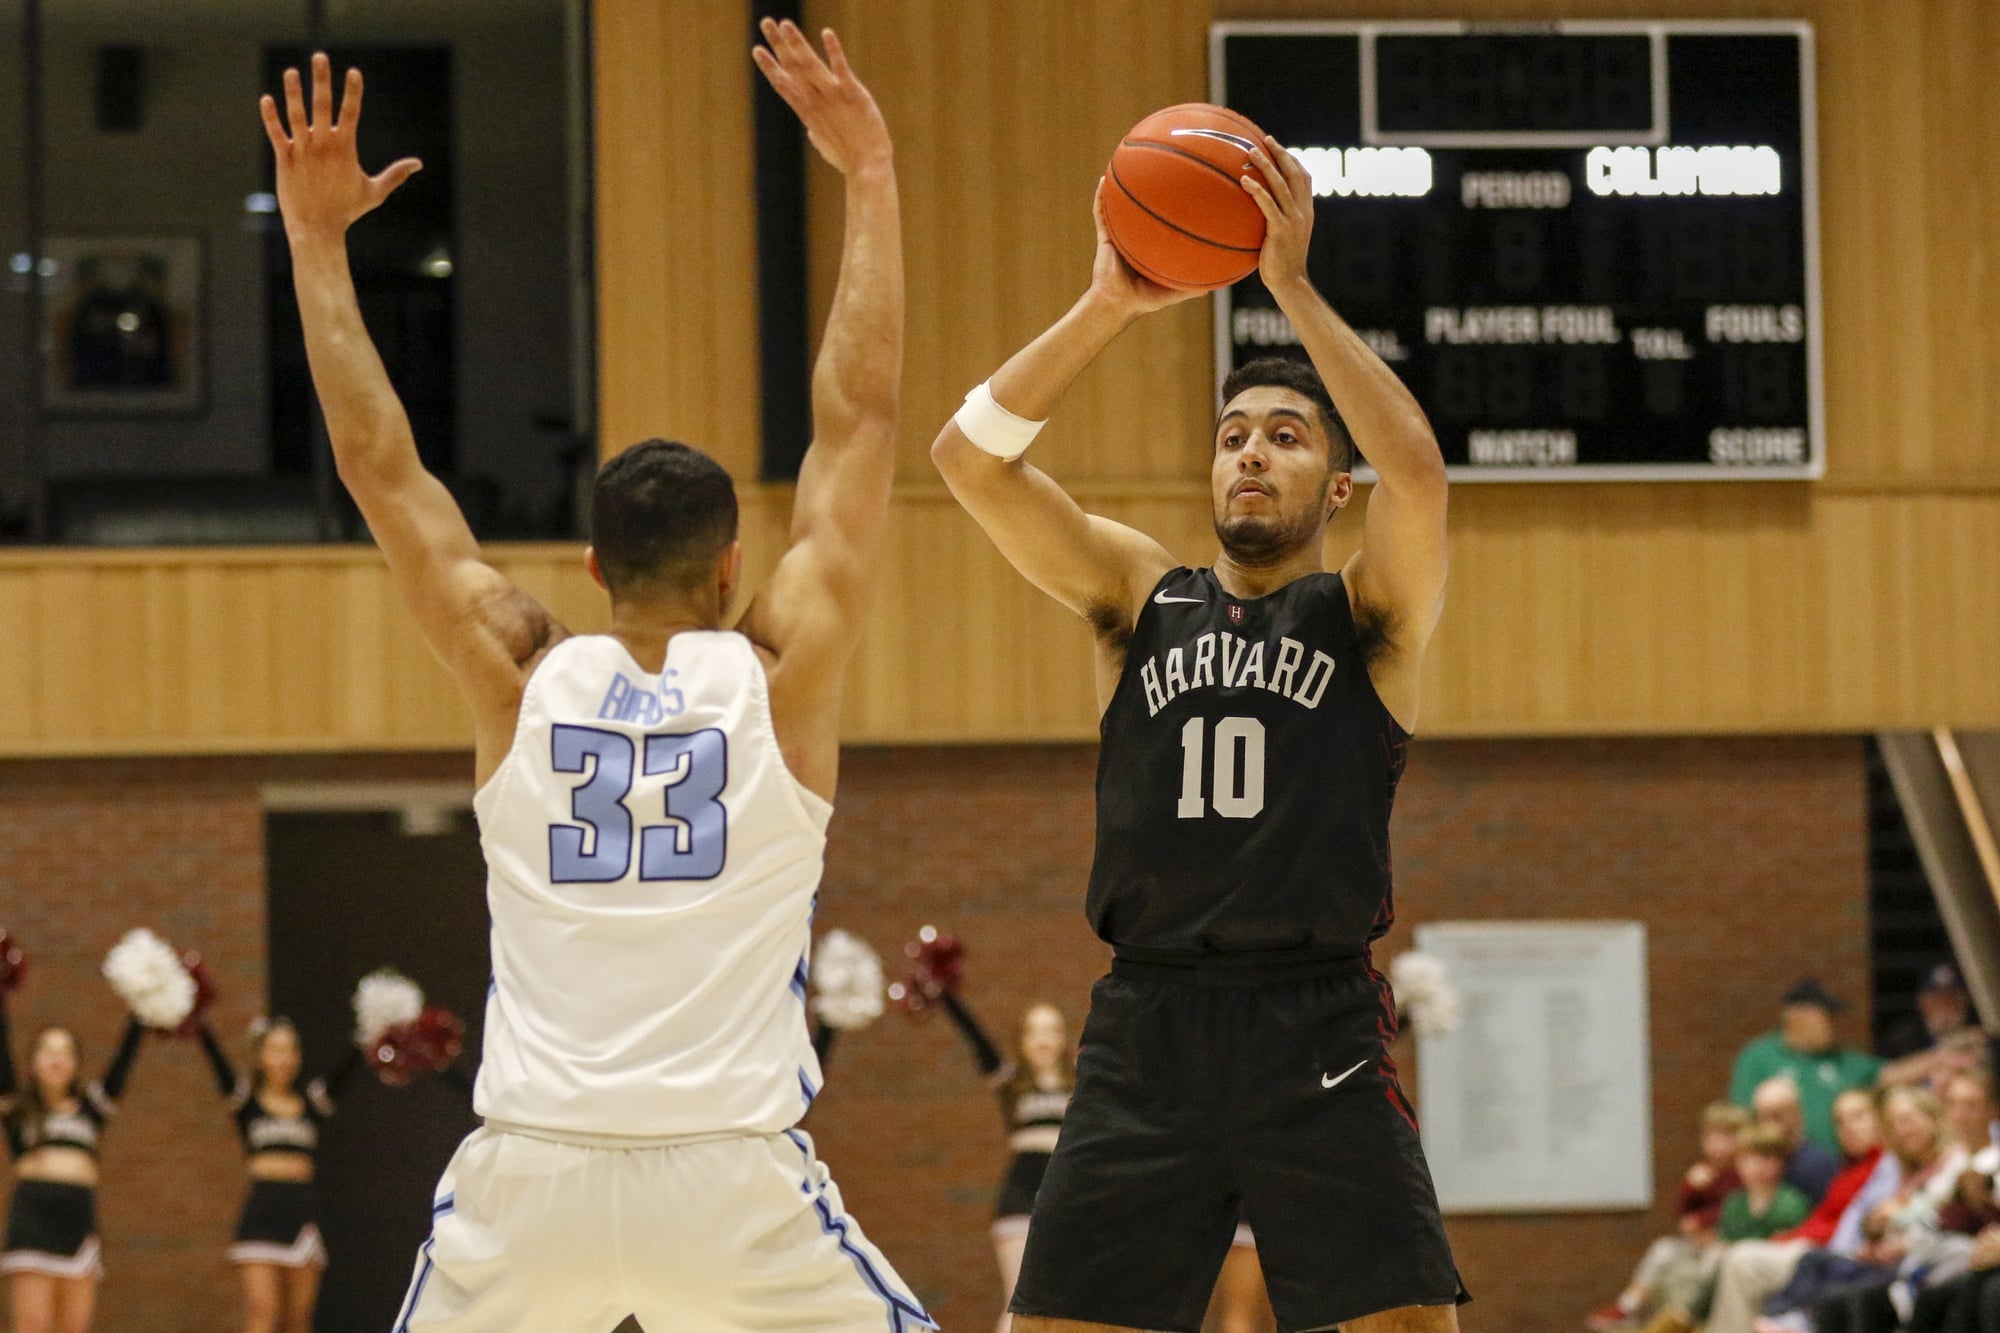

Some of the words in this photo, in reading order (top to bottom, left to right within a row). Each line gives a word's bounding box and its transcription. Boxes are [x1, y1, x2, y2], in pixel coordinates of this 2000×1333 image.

[1425, 306, 1539, 345] PLAYER
[1542, 306, 1620, 344] FOUL
[1705, 304, 1803, 343] FOULS
[1469, 429, 1577, 466] MATCH
[1709, 427, 1804, 466] SCORE
[1140, 631, 1336, 718] HARVARD
[1178, 716, 1266, 819] 10
[548, 723, 728, 884] 33
